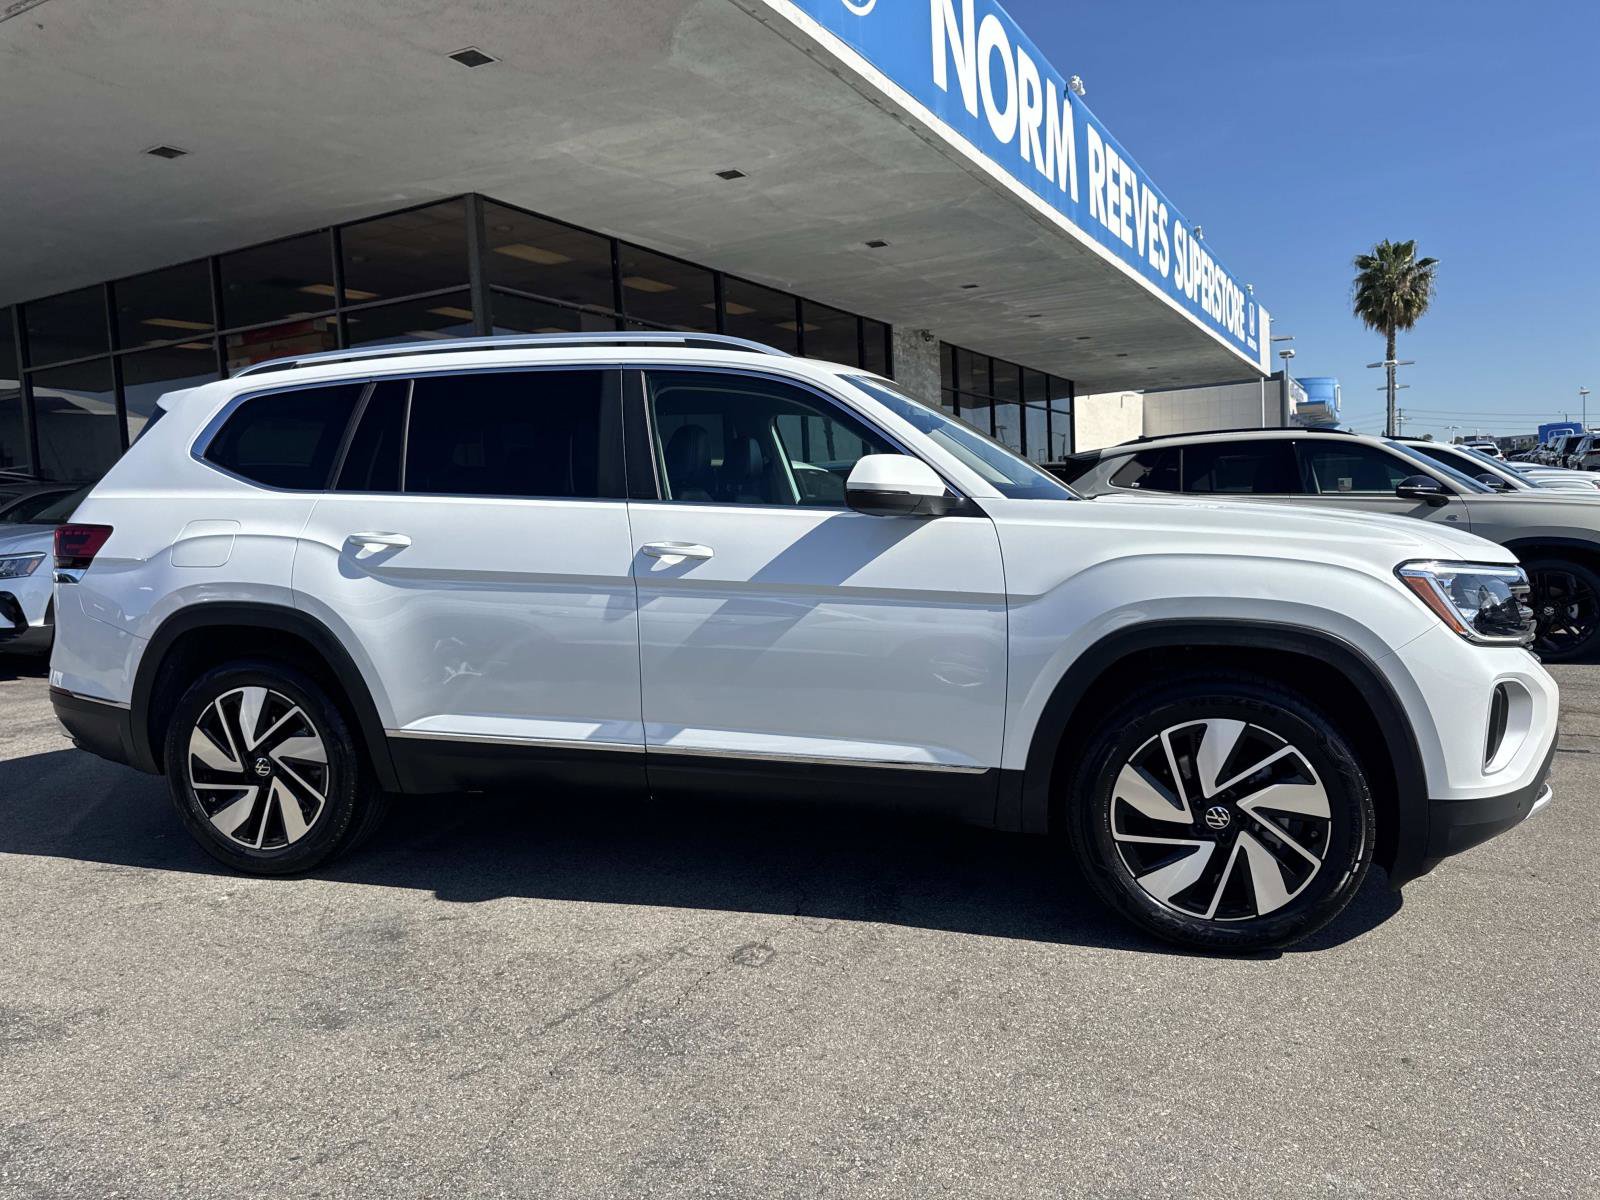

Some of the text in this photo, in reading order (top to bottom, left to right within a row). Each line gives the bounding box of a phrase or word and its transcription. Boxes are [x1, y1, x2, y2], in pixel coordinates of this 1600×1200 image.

[930, 0, 1246, 343] NORM REEVES SUPERSTORE
